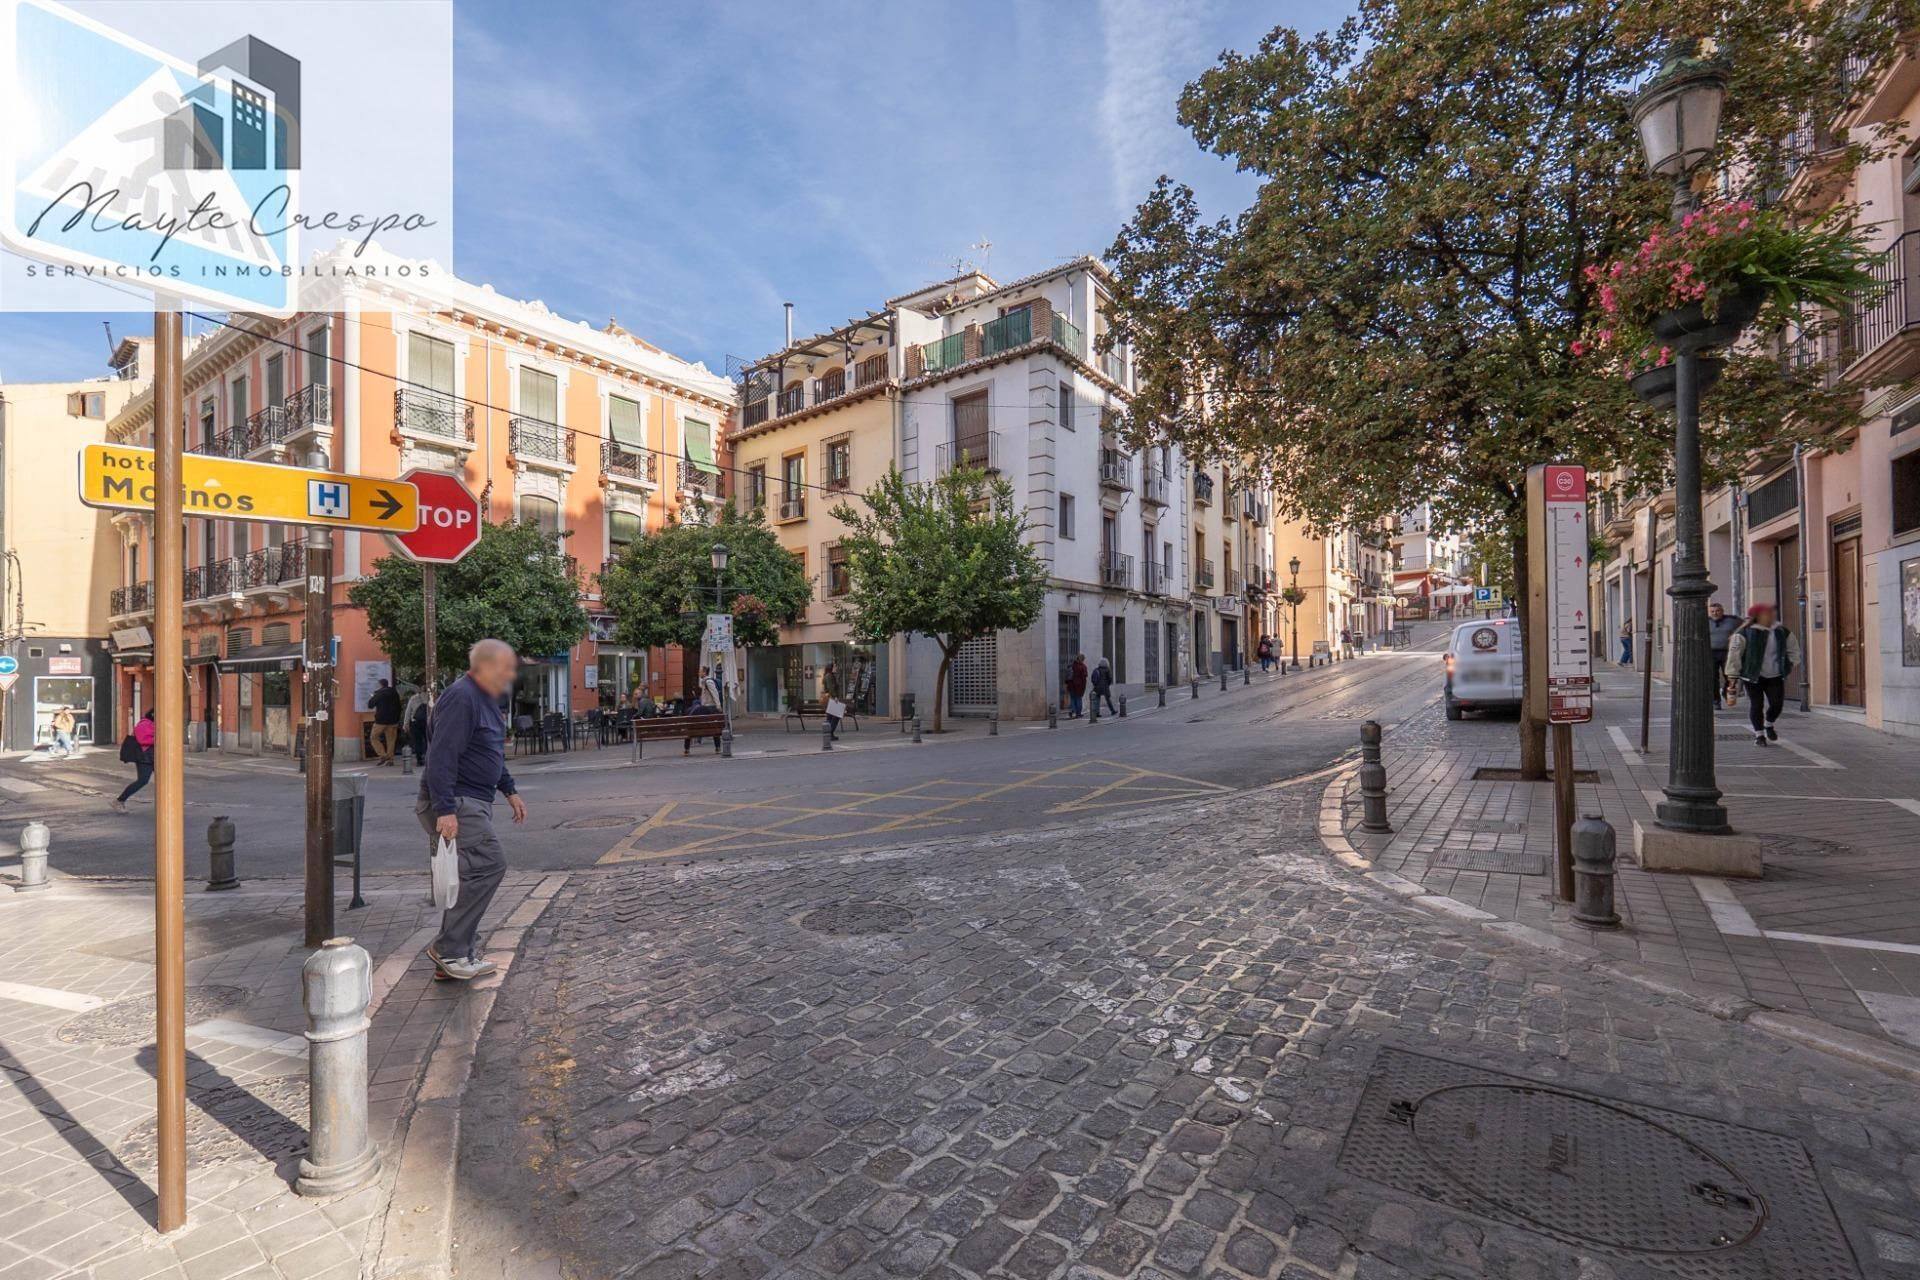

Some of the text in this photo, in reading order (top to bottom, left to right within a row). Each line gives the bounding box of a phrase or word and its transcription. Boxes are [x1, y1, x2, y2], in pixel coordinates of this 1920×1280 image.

[102, 451, 156, 472] hote
[102, 474, 255, 512] Moinos
[318, 483, 340, 508] H
[418, 504, 472, 529] TOP
[1478, 589, 1488, 600] P
